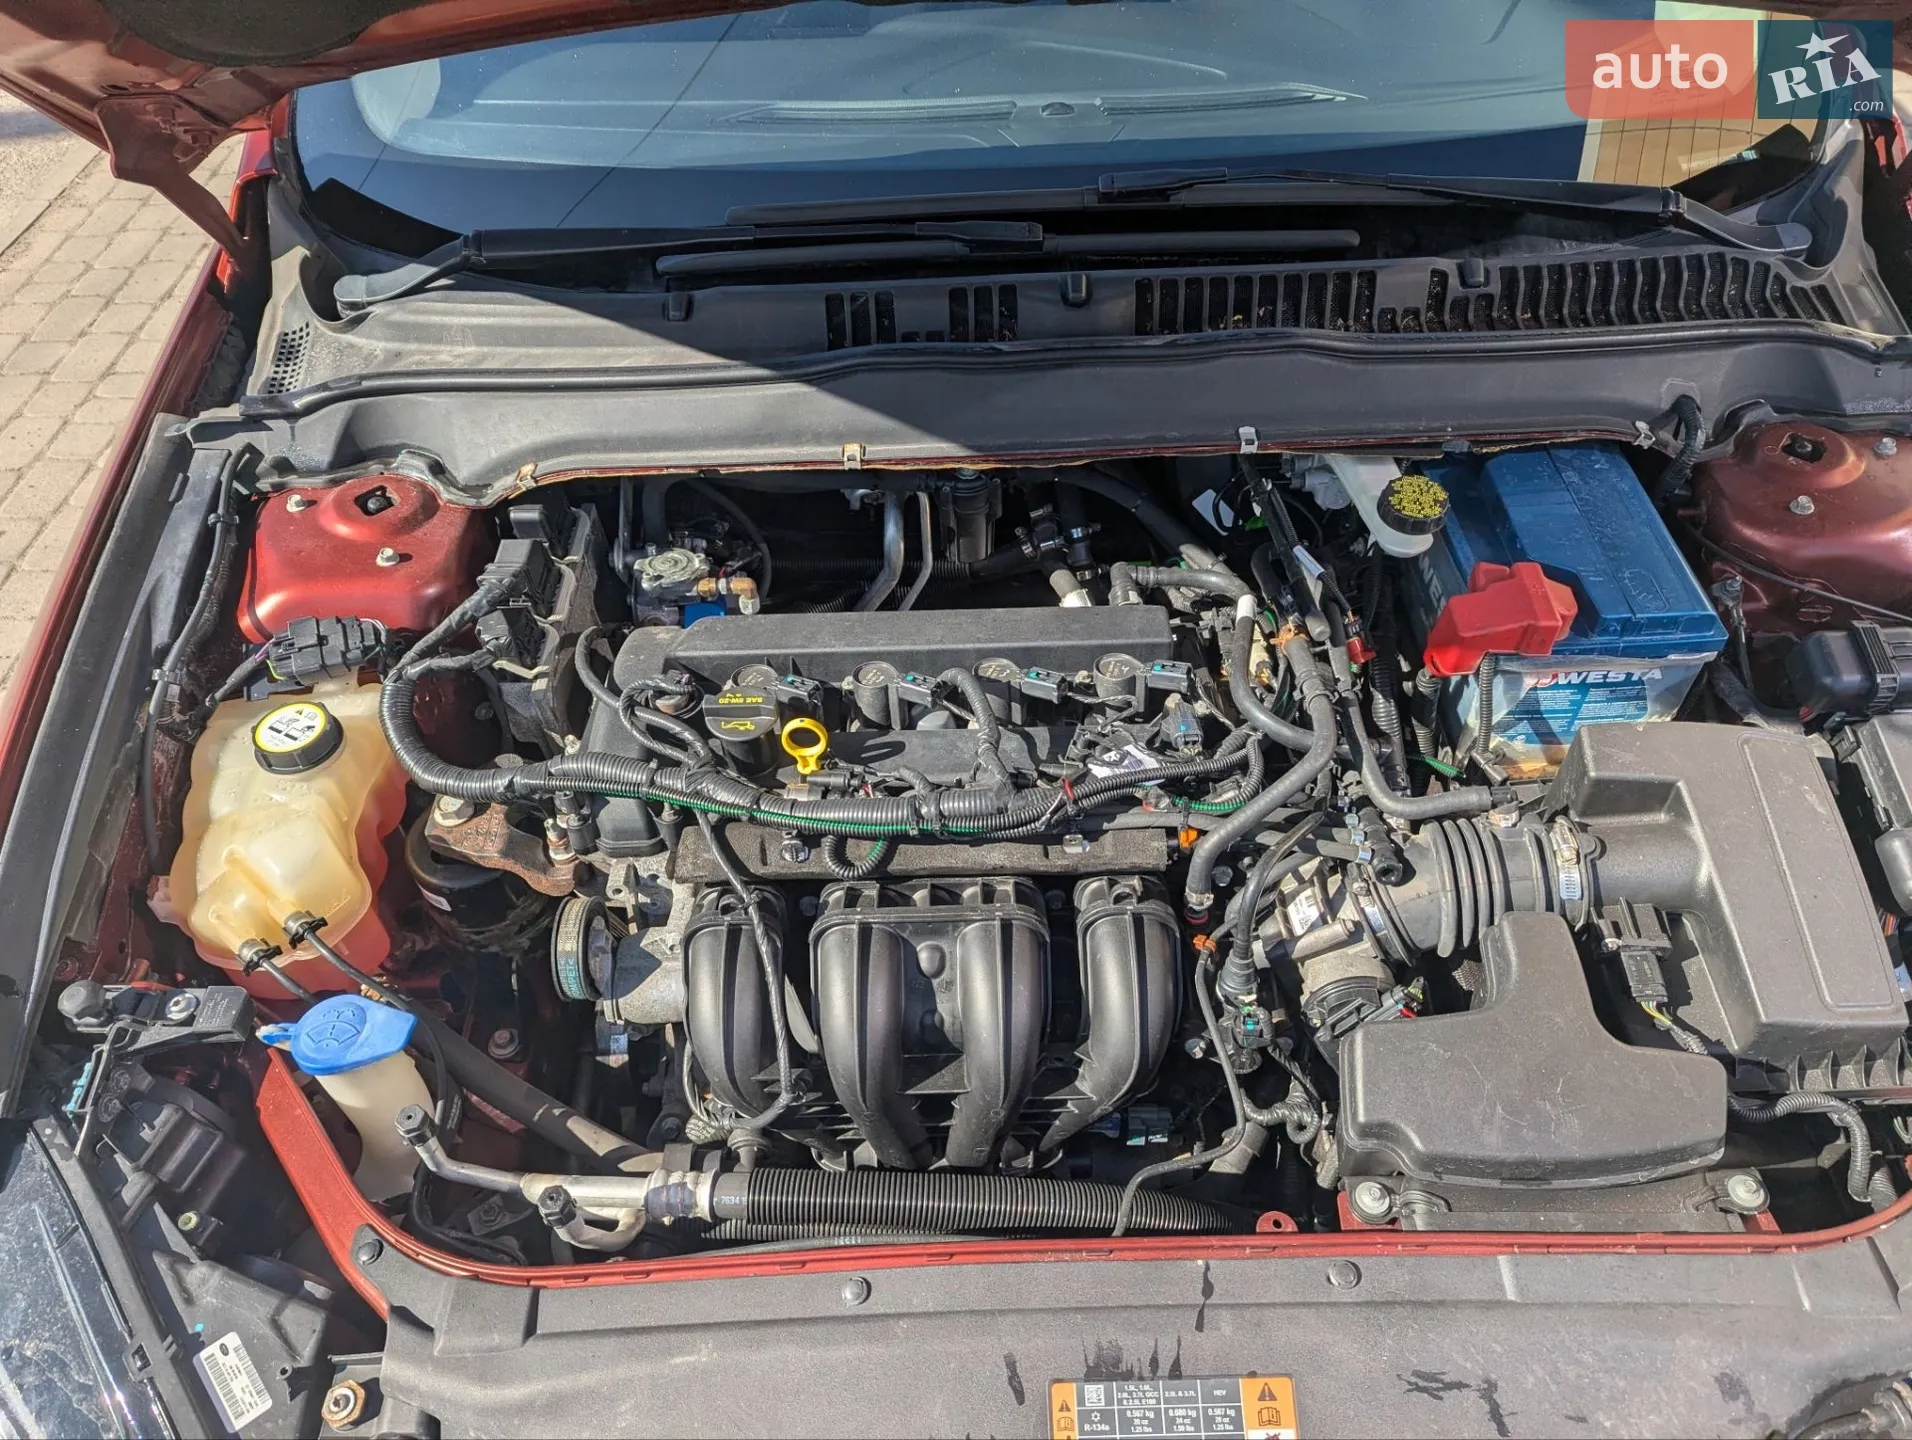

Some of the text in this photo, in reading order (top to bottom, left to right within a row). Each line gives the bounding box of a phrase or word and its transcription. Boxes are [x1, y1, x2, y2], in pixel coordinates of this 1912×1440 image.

[1557, 667, 1663, 685] WESTA
[1145, 1409, 1155, 1418] kg
[1187, 1408, 1197, 1417] kg
[1226, 1407, 1236, 1416] kg
[1084, 1423, 1110, 1432] R-134a
